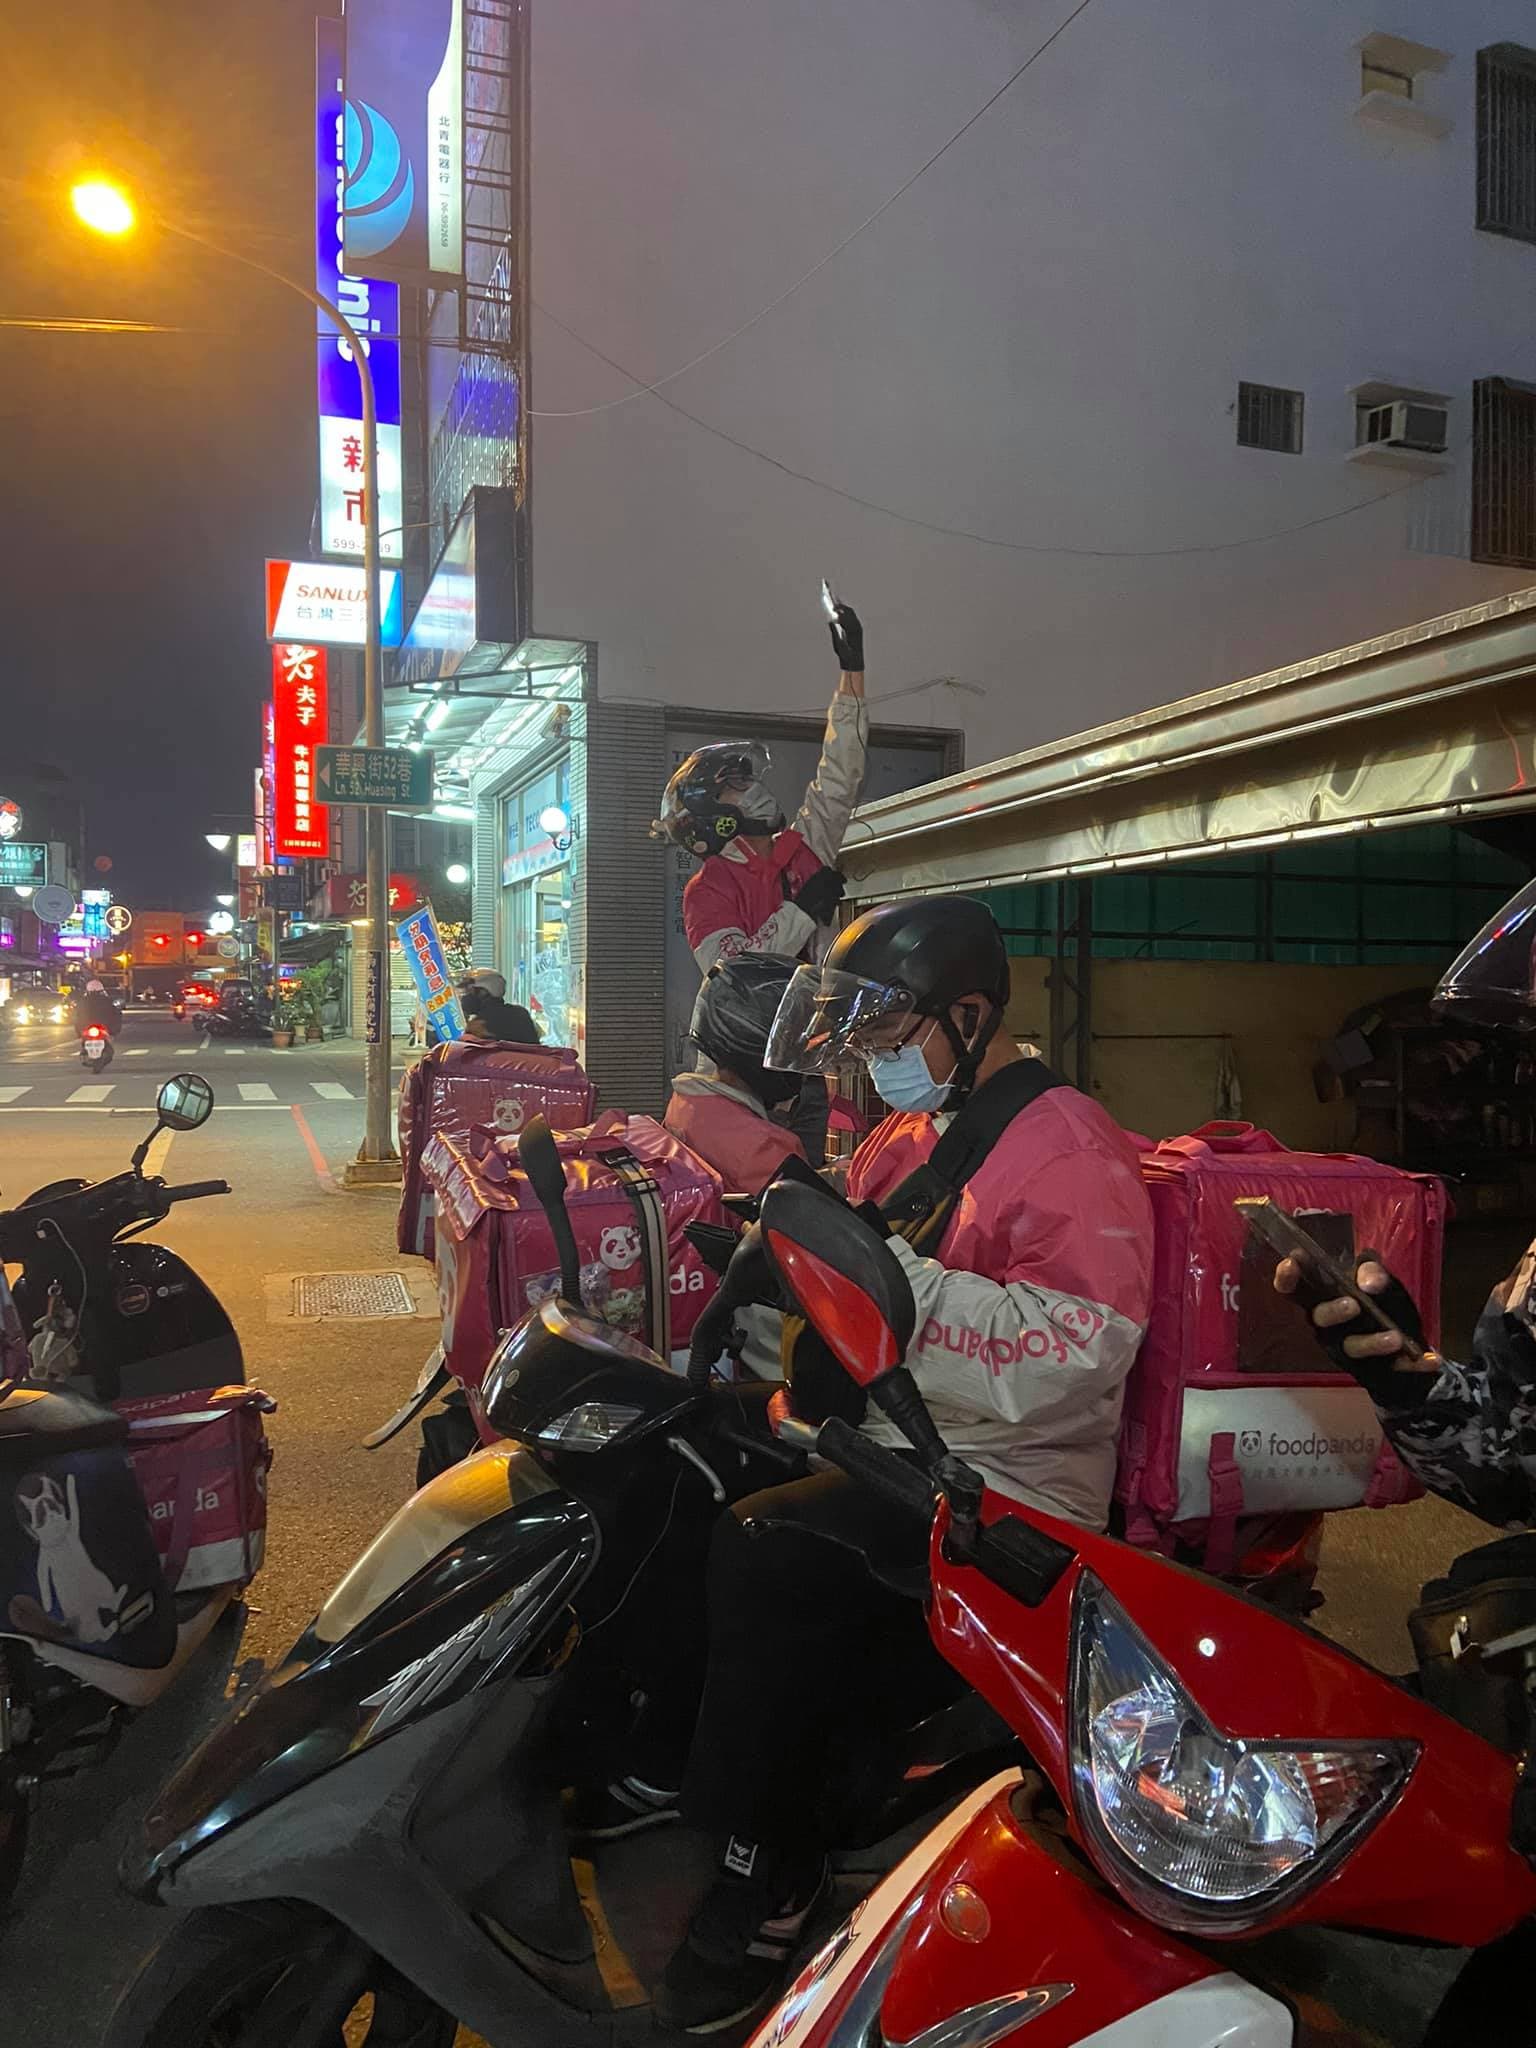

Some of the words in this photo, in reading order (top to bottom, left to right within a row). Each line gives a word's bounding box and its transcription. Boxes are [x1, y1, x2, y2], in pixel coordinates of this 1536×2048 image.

[282, 644, 318, 726] 老夫子
[348, 879, 400, 909] 老子
[1268, 1432, 1376, 1458] foodpanda
